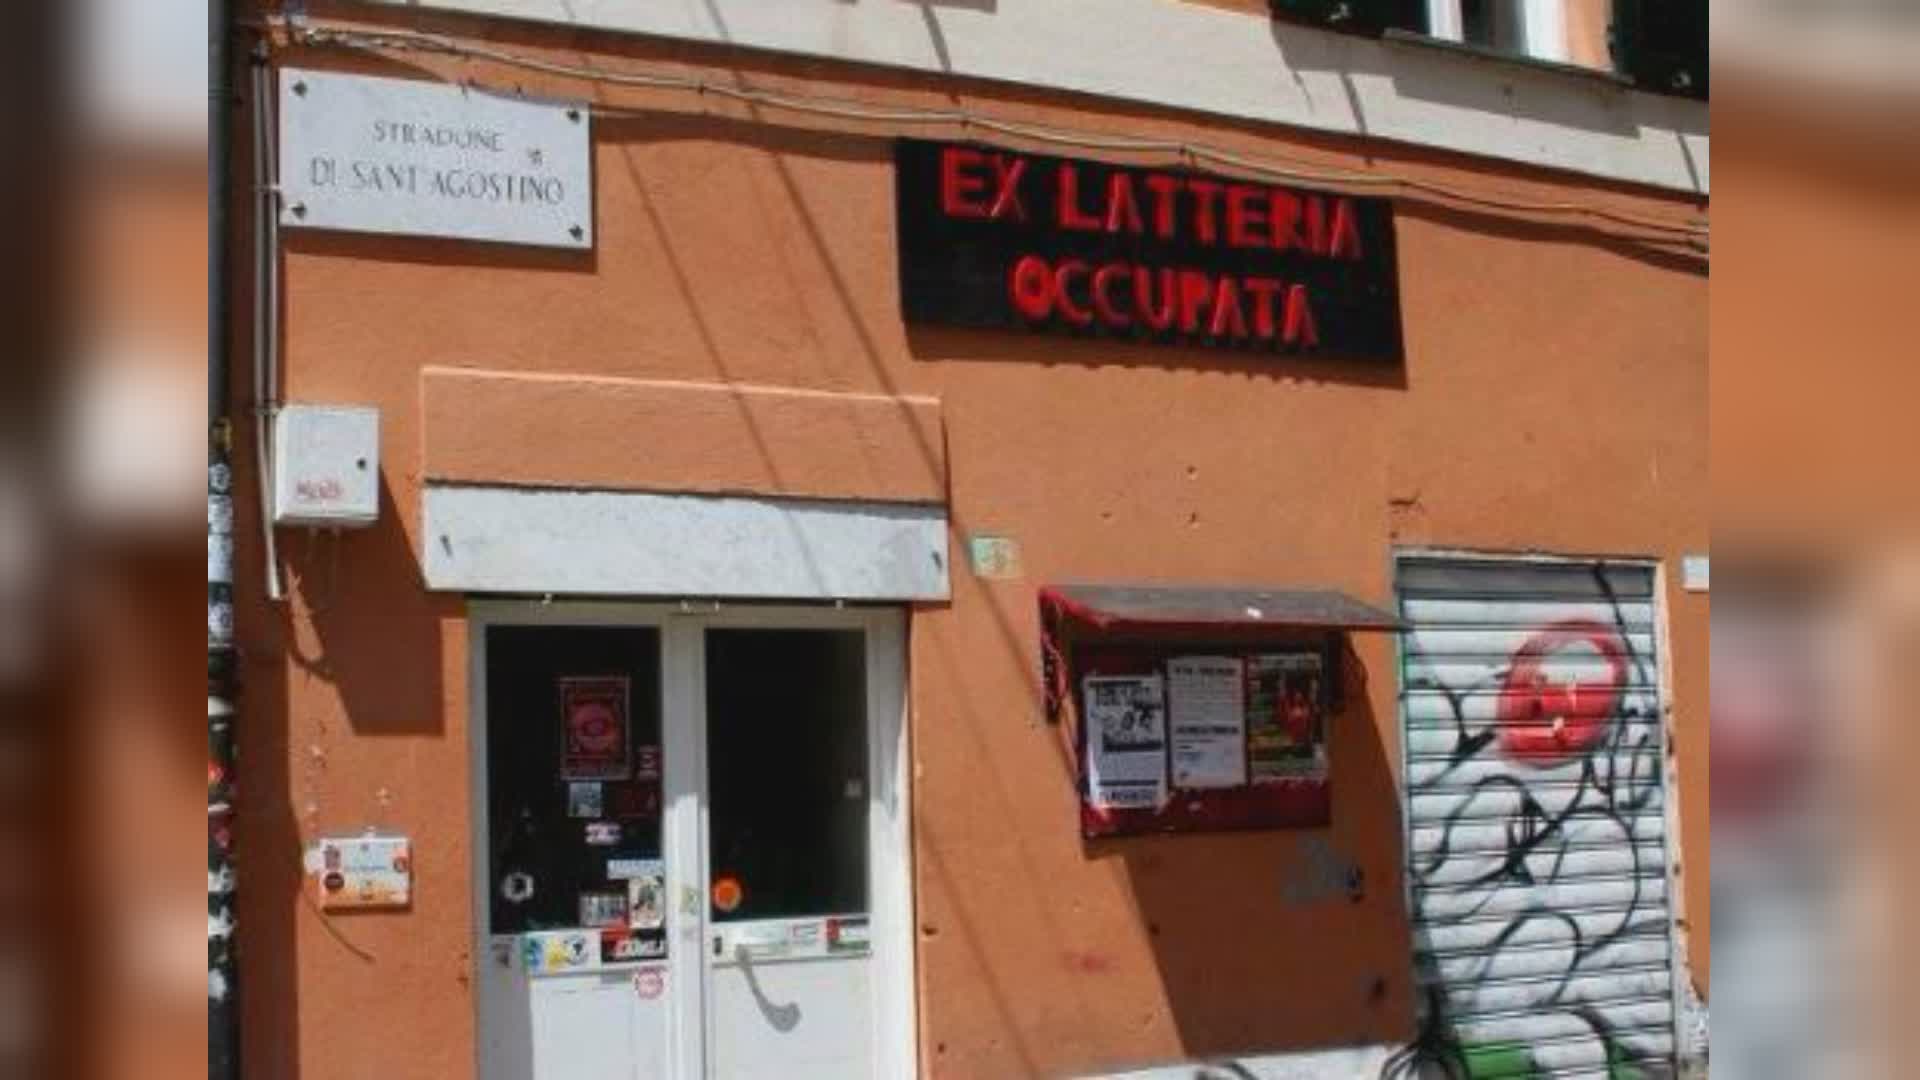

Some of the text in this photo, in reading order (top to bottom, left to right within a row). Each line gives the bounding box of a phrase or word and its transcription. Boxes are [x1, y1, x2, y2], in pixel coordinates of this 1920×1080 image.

[373, 120, 505, 153] STRADONE
[309, 156, 337, 188] DI
[429, 168, 566, 206] AGOSTINO
[942, 147, 1363, 261] EX LATTERIA
[1011, 255, 1319, 346] OCCUPATA
